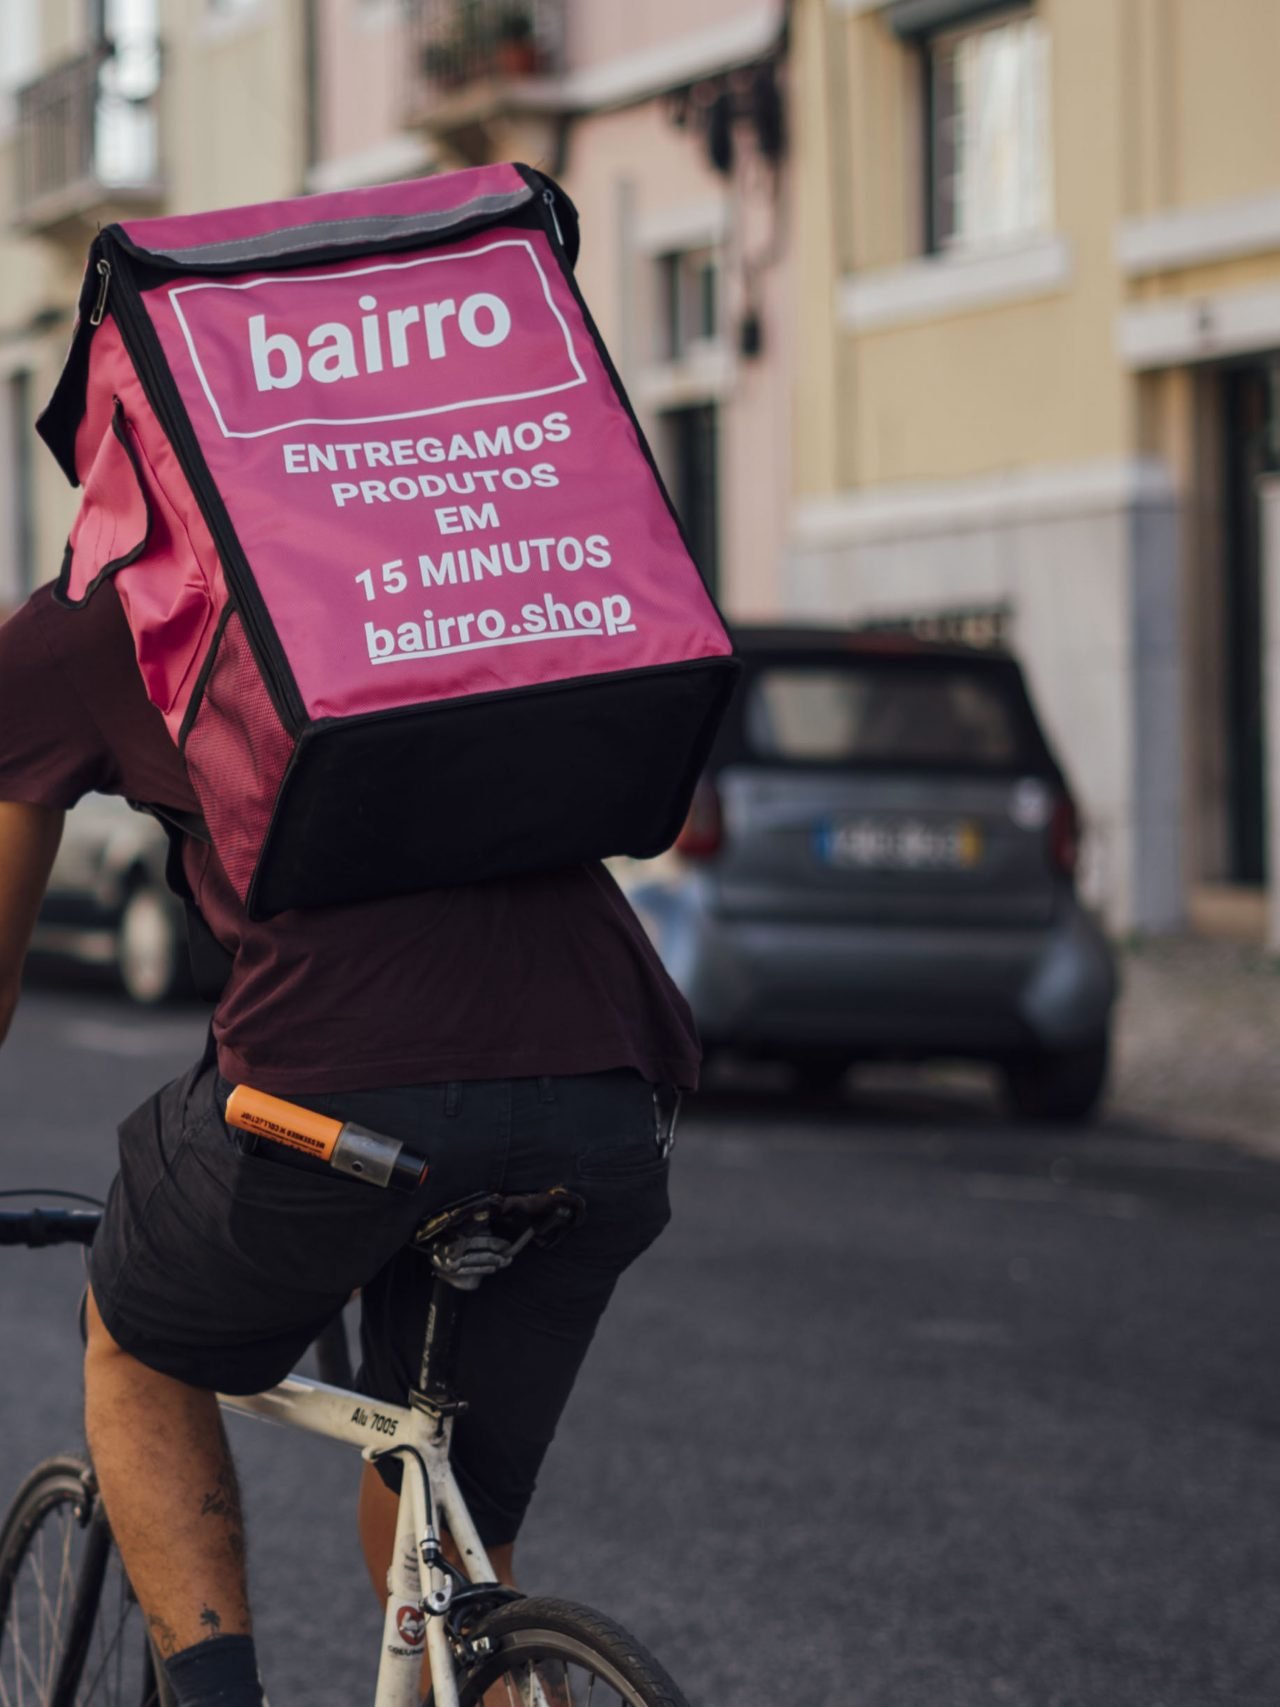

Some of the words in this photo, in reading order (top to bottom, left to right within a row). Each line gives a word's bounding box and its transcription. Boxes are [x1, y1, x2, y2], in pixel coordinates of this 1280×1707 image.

[247, 292, 512, 392] bairro
[282, 411, 572, 474] ENTREGAMOS
[330, 462, 560, 508] PRODUTOS
[434, 502, 501, 535] EM
[354, 558, 408, 602] 15
[418, 534, 612, 588] MINUTOS
[363, 592, 632, 660] bairro.shop
[351, 1408, 368, 1426] Alu
[371, 1413, 399, 1436] 7005
